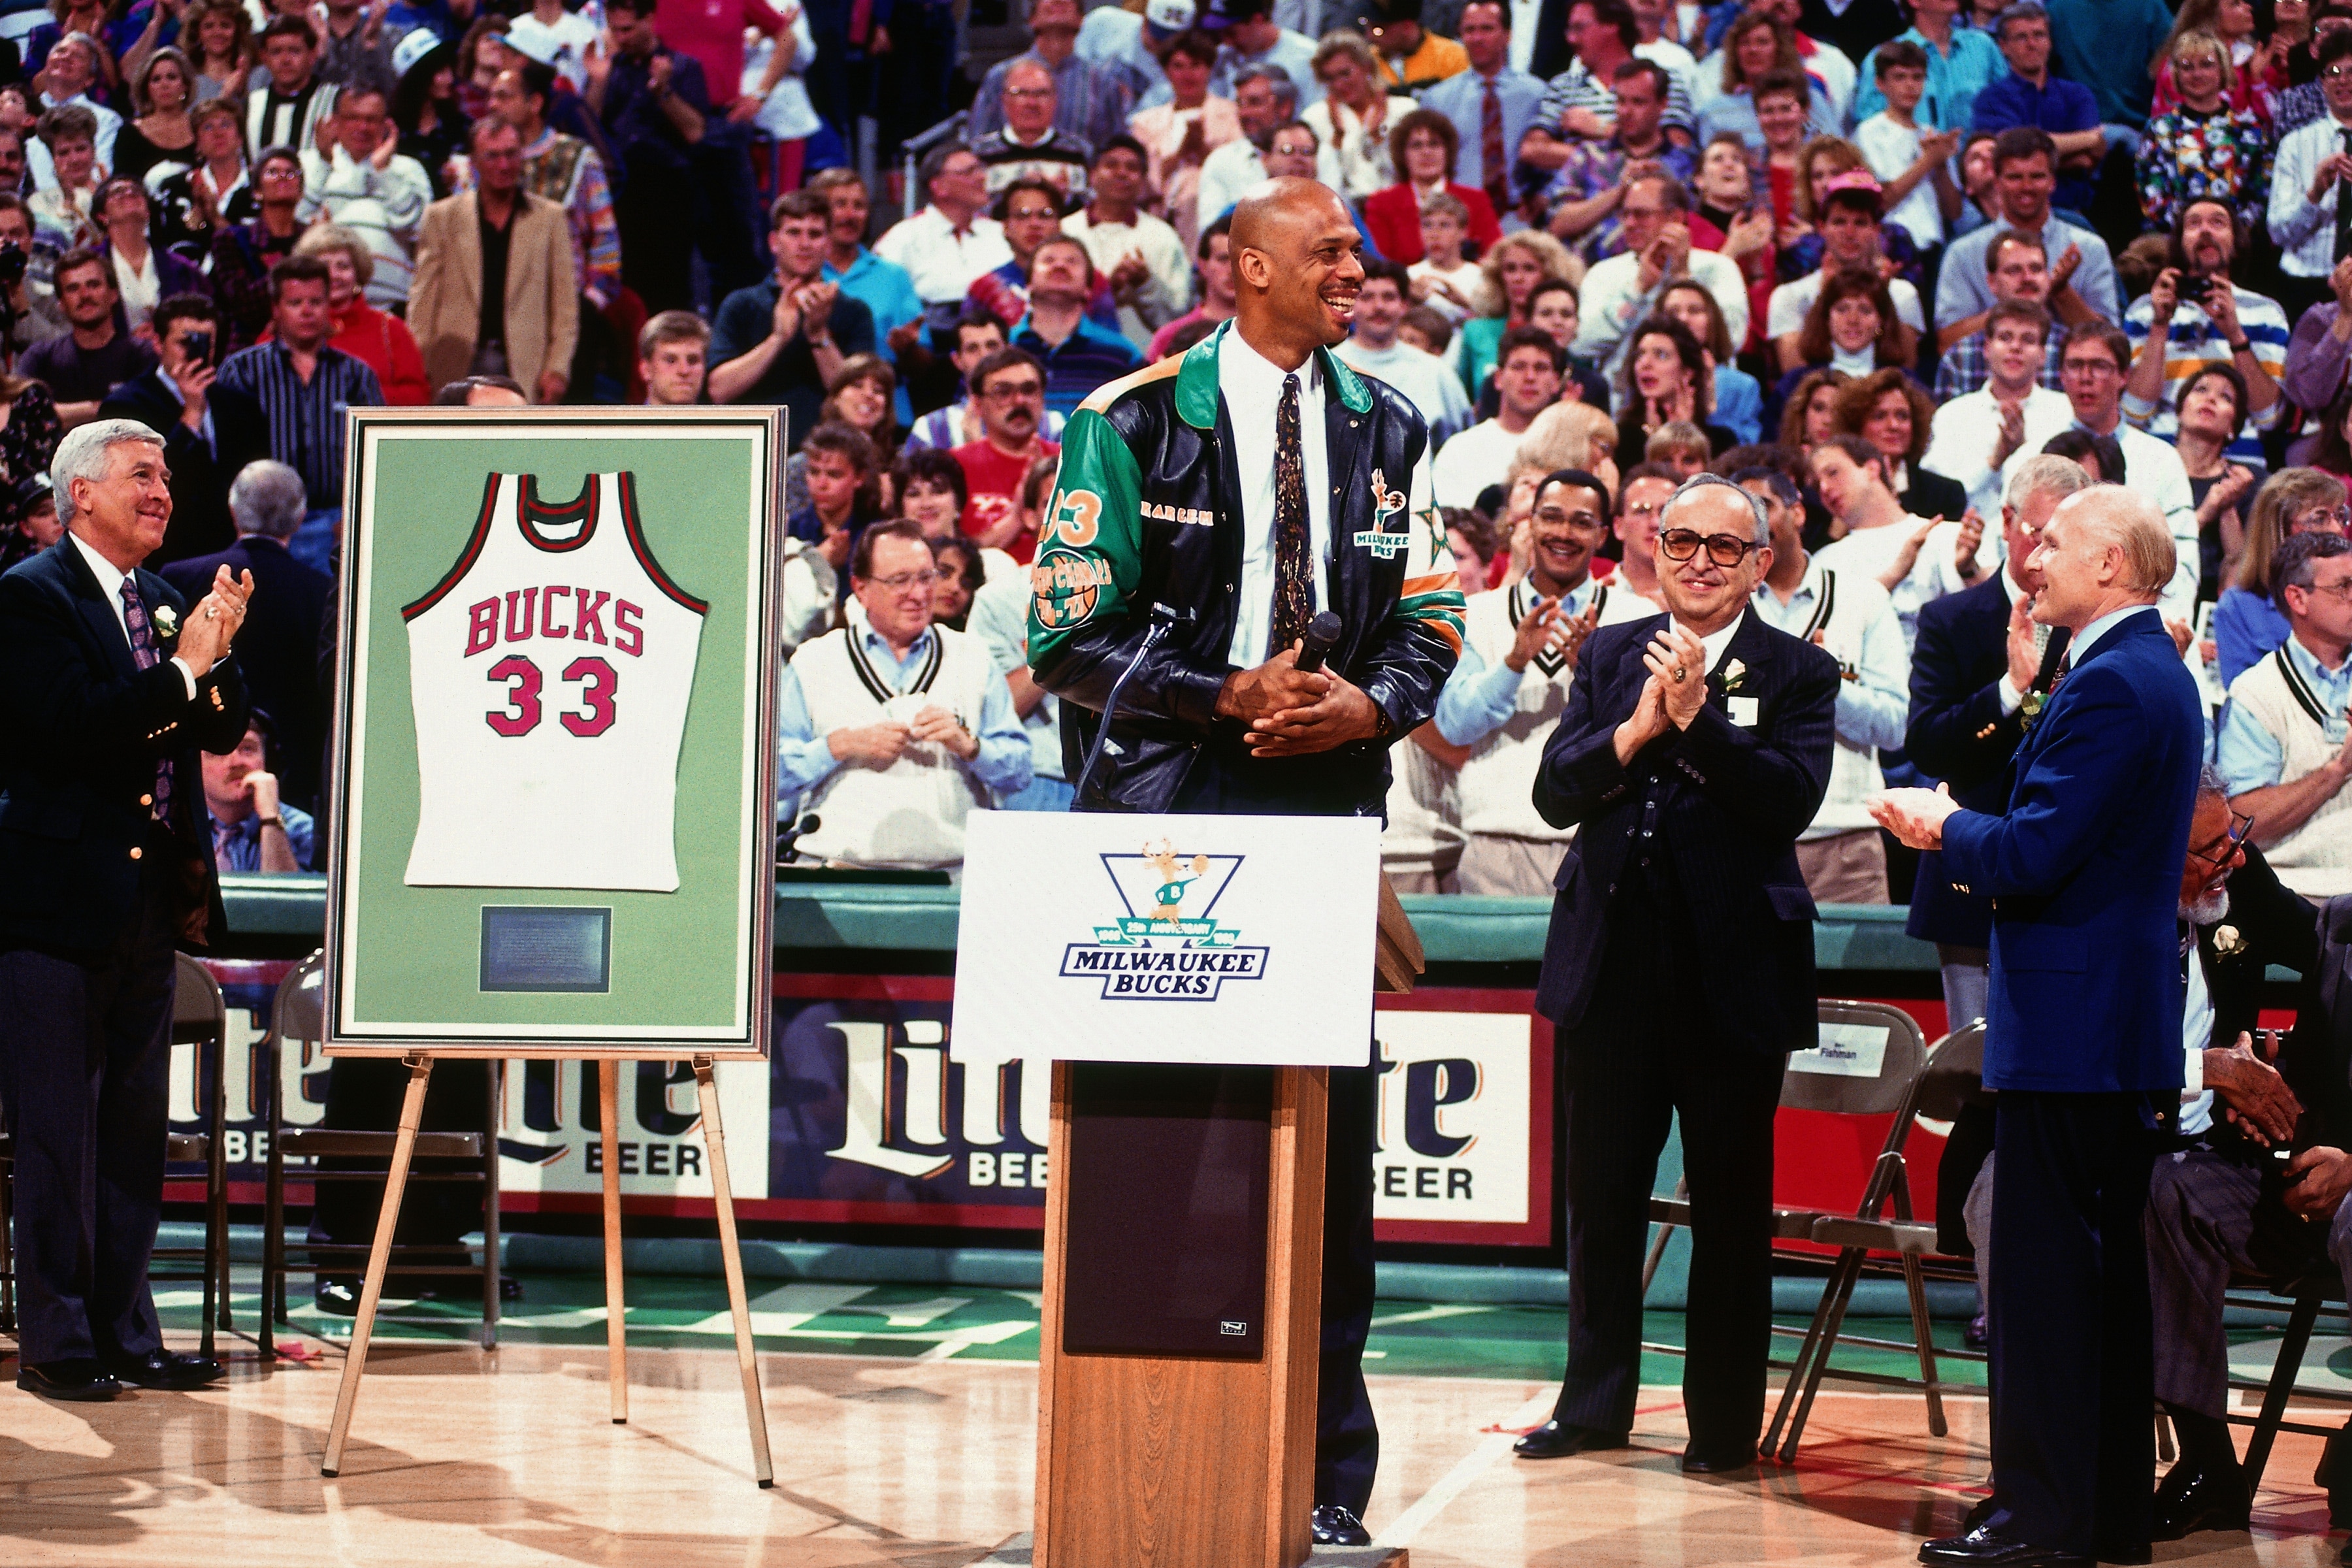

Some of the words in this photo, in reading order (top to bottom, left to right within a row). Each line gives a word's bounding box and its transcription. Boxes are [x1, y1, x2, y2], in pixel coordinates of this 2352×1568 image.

[465, 585, 643, 657] BUCKS
[485, 654, 618, 738] 33
[1073, 951, 1256, 972] MILWAUKEE
[1113, 974, 1210, 994] BUCKS
[968, 1151, 1049, 1188] BEE
[1372, 1166, 1473, 1200] EER
